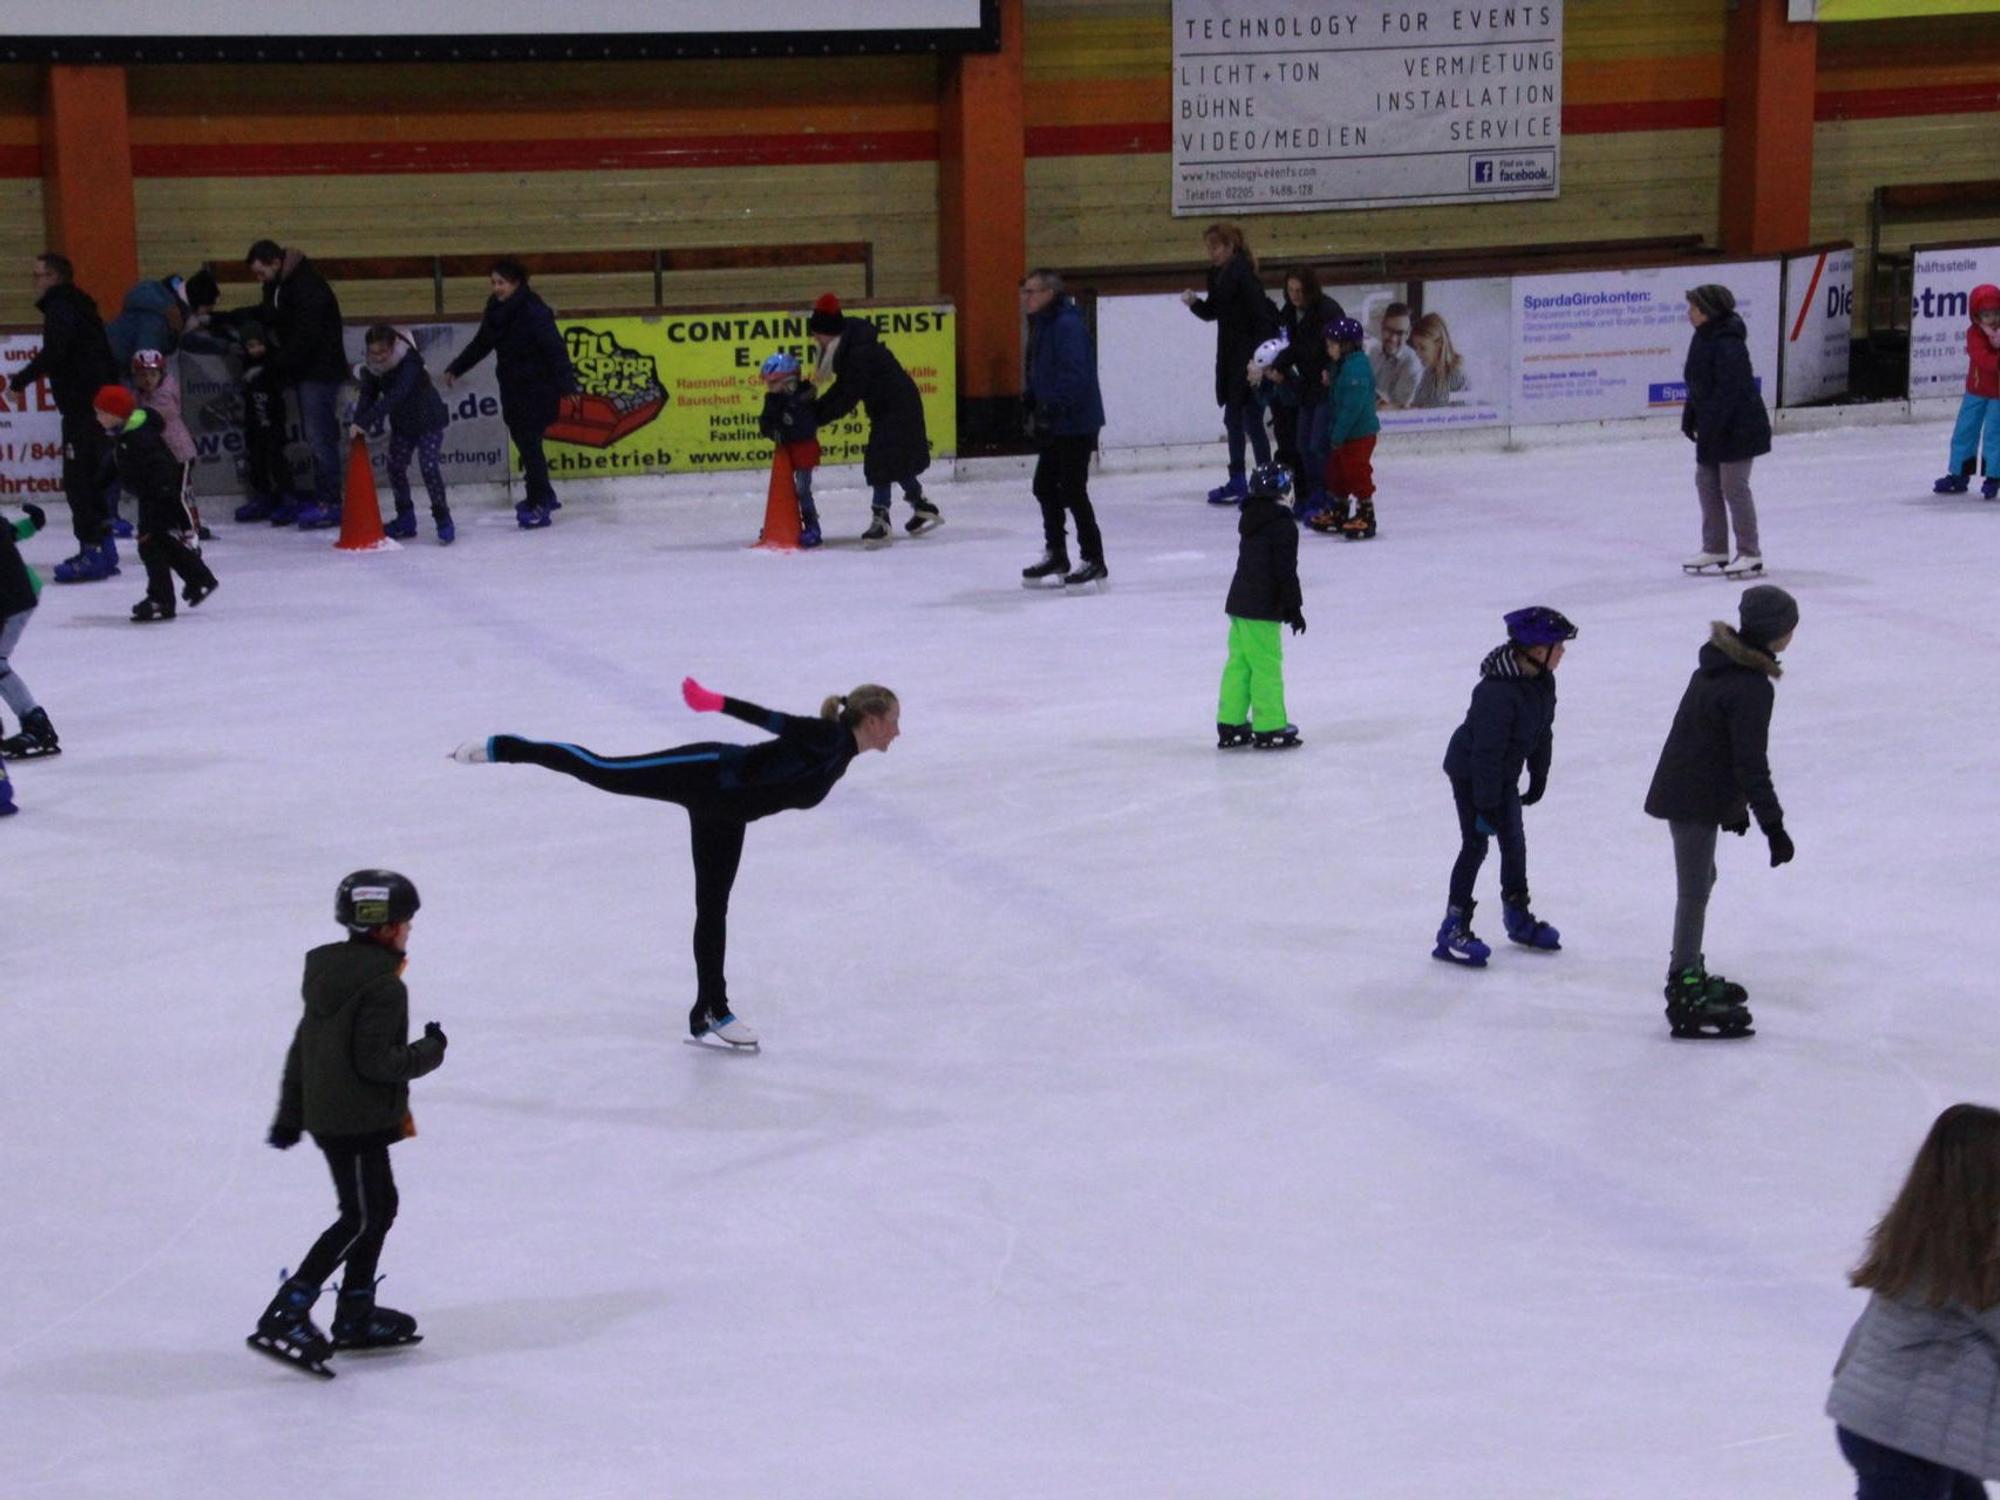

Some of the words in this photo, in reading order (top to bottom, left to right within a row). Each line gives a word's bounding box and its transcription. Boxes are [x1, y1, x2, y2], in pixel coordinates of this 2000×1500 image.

[1185, 15, 1358, 40] TECHNOLOGY
[1382, 12, 1428, 33] FOR
[1453, 6, 1550, 31] EVENTS
[1404, 51, 1554, 77] VERMIETUNG
[1181, 94, 1254, 119] BÜHNE
[1376, 84, 1553, 112] INSTALLATION
[1180, 126, 1367, 151] VIDEO/MEDIEN
[1450, 117, 1552, 141] SERVICE
[1915, 259, 1977, 273] häftsstelle
[1523, 291, 1652, 311] SpardaGirokonten:
[1662, 386, 1688, 402] Spa
[438, 447, 502, 468] erbung!
